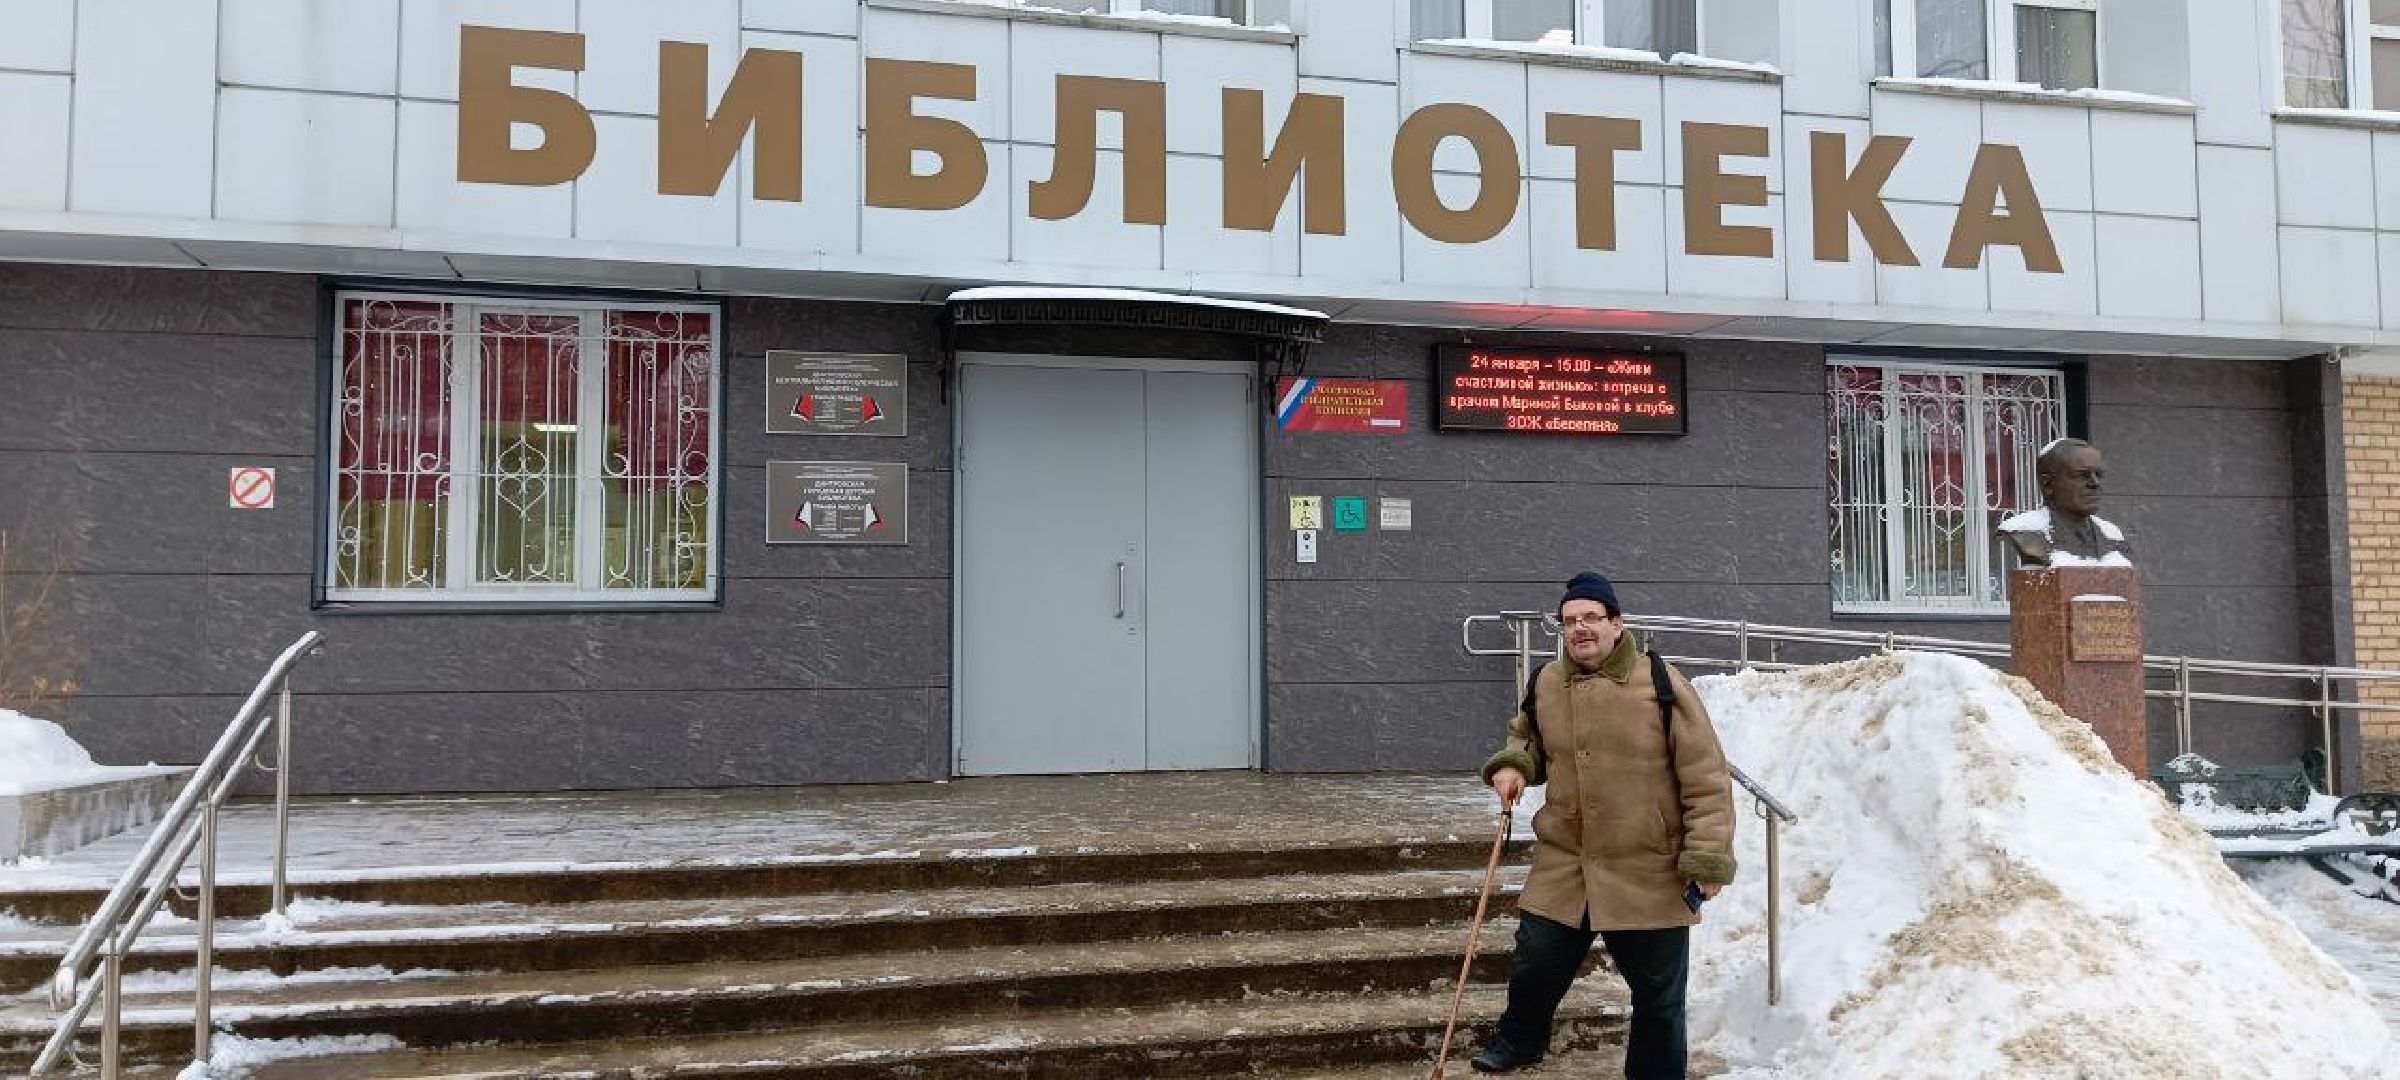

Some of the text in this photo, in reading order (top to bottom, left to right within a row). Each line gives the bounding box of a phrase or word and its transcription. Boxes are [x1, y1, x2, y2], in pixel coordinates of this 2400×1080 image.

[457, 24, 2065, 274] БИБЛИОТЕКА
[1470, 355, 1488, 368] 24
[1492, 359, 1540, 373] января
[1557, 359, 1591, 373] 15.00
[1455, 375, 1534, 390] счастливой
[1604, 382, 1654, 396] встреча
[1658, 385, 1667, 394] с
[1450, 395, 1675, 417] врачом Мариной Быковой в клубе
